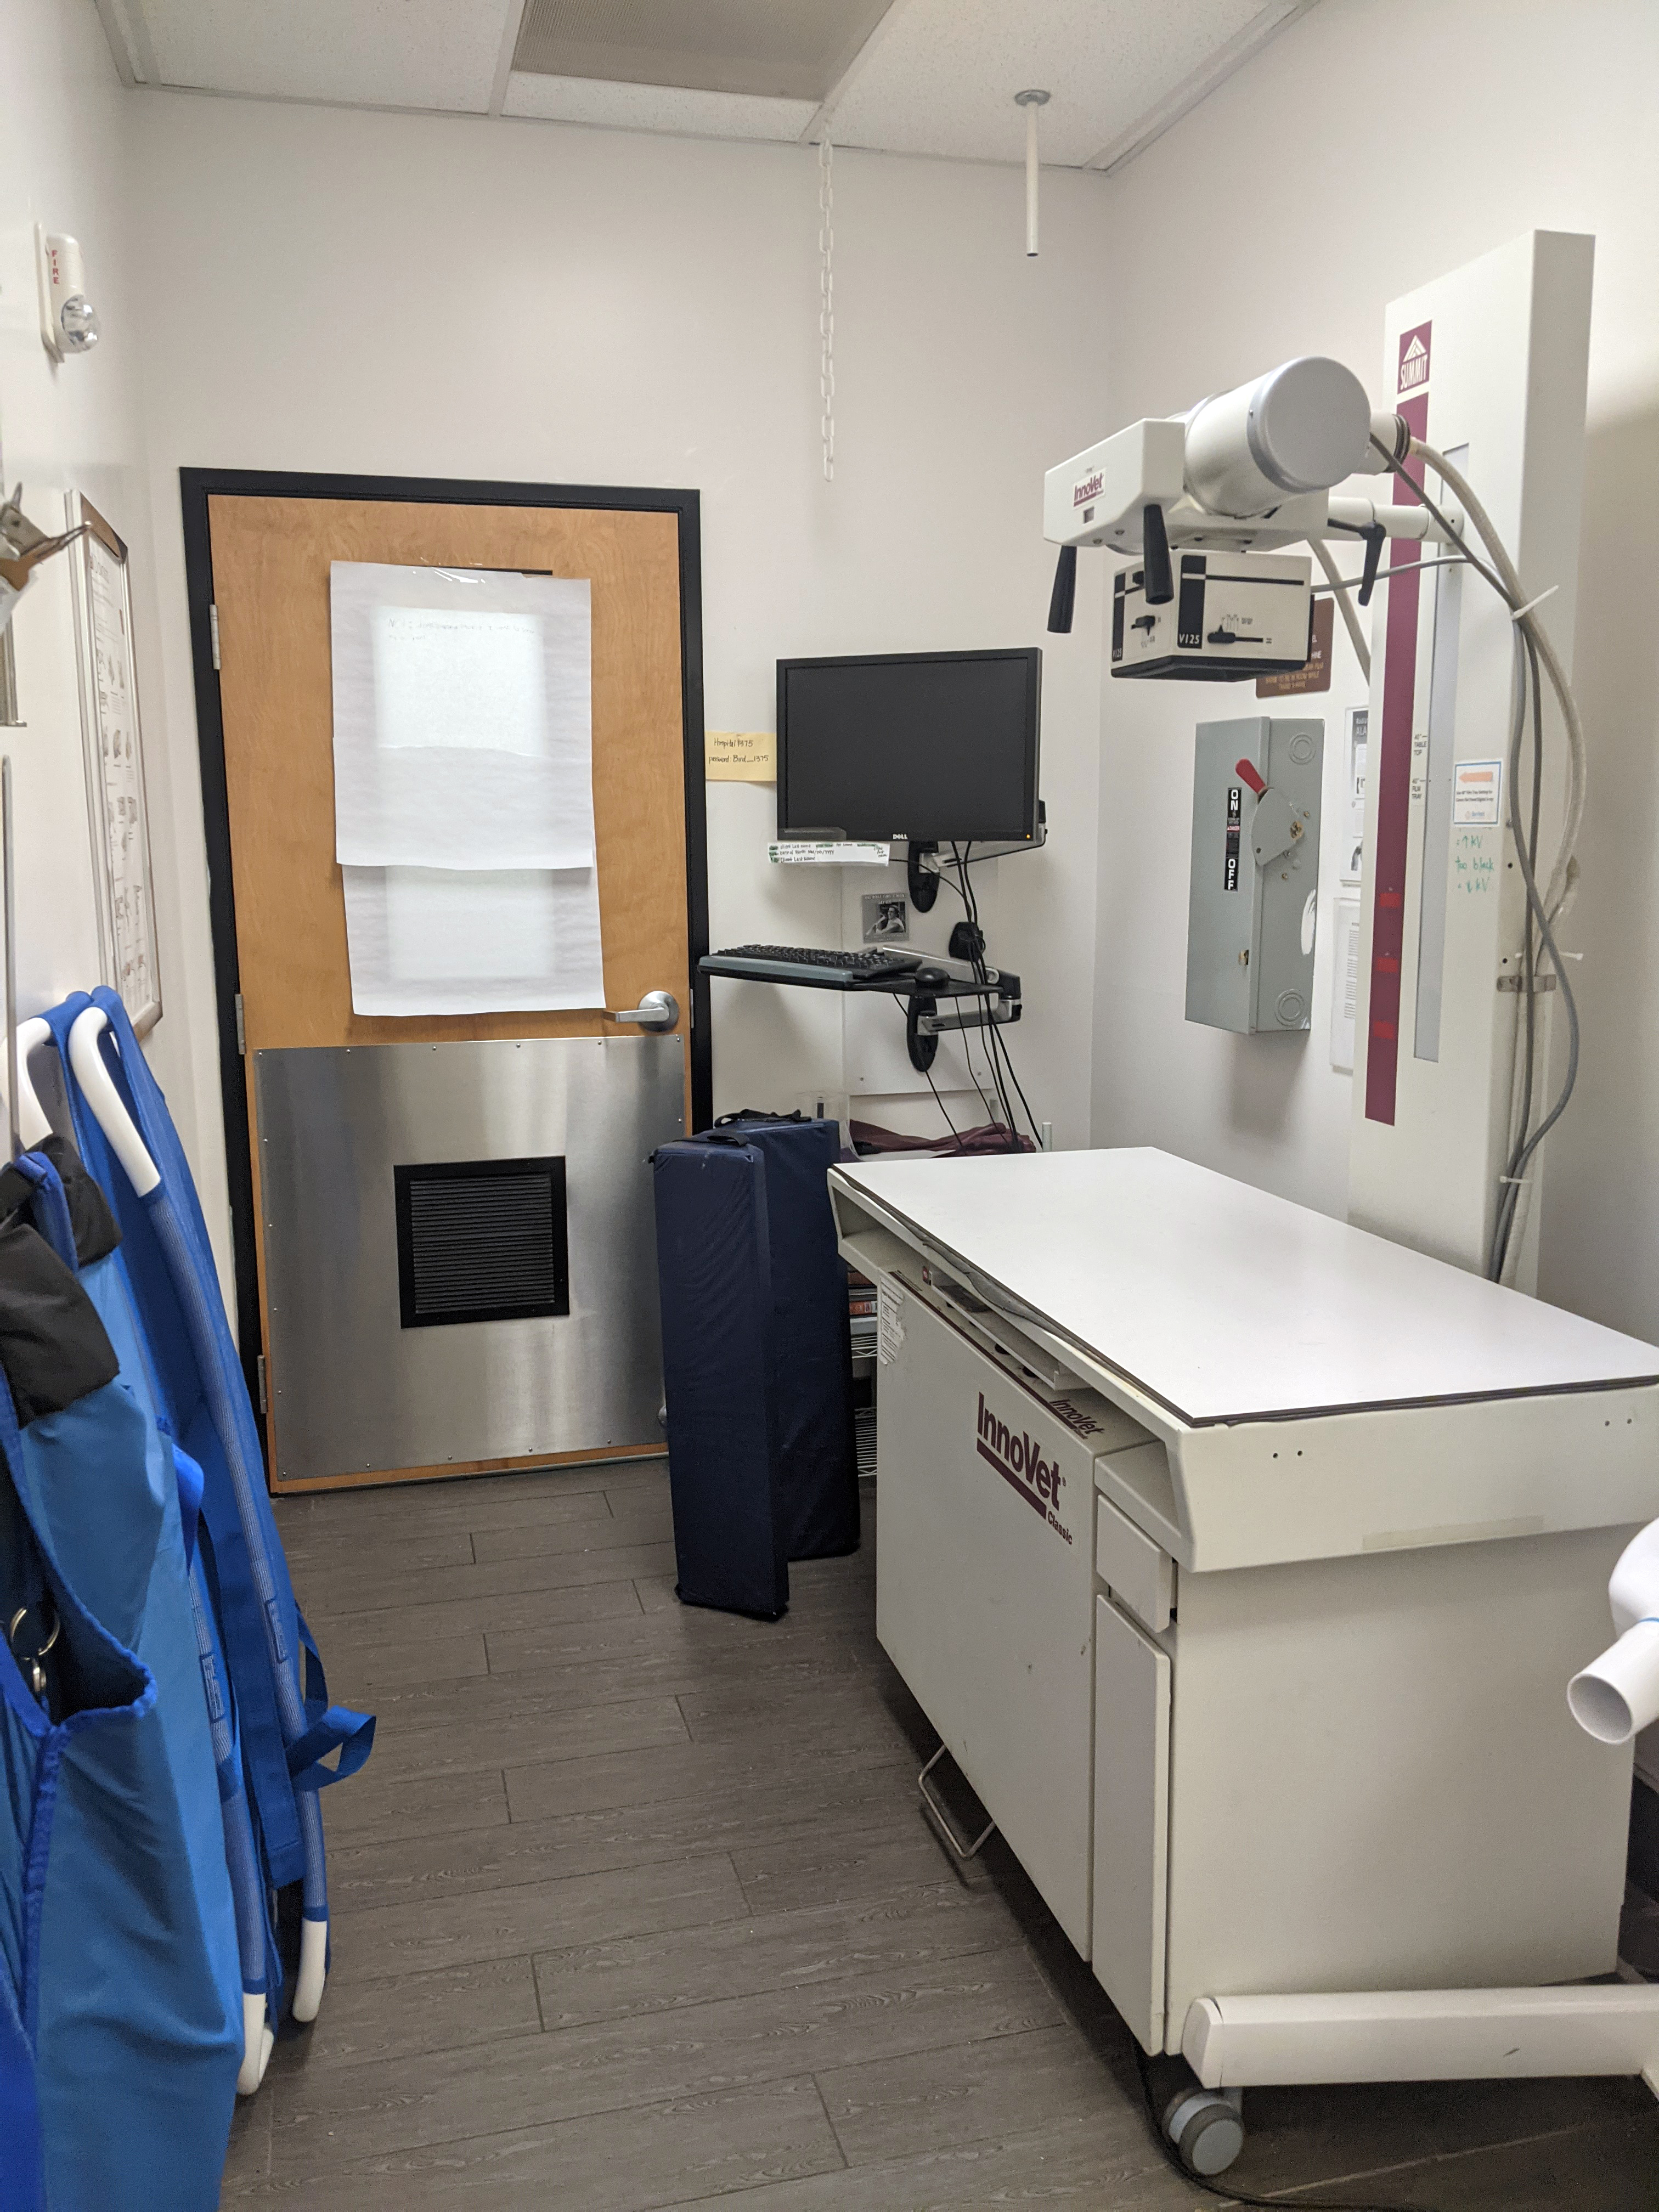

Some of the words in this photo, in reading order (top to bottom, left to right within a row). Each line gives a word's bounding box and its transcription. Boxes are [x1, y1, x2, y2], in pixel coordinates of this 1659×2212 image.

[52, 250, 60, 284] FIRE
[1074, 472, 1103, 501] InnoVet
[1230, 789, 1239, 811] ON
[1227, 858, 1236, 890] OFF
[1049, 1399, 1105, 1434] InnoVet
[978, 1391, 1061, 1511] InnoVet
[1048, 1510, 1073, 1545] Classic
